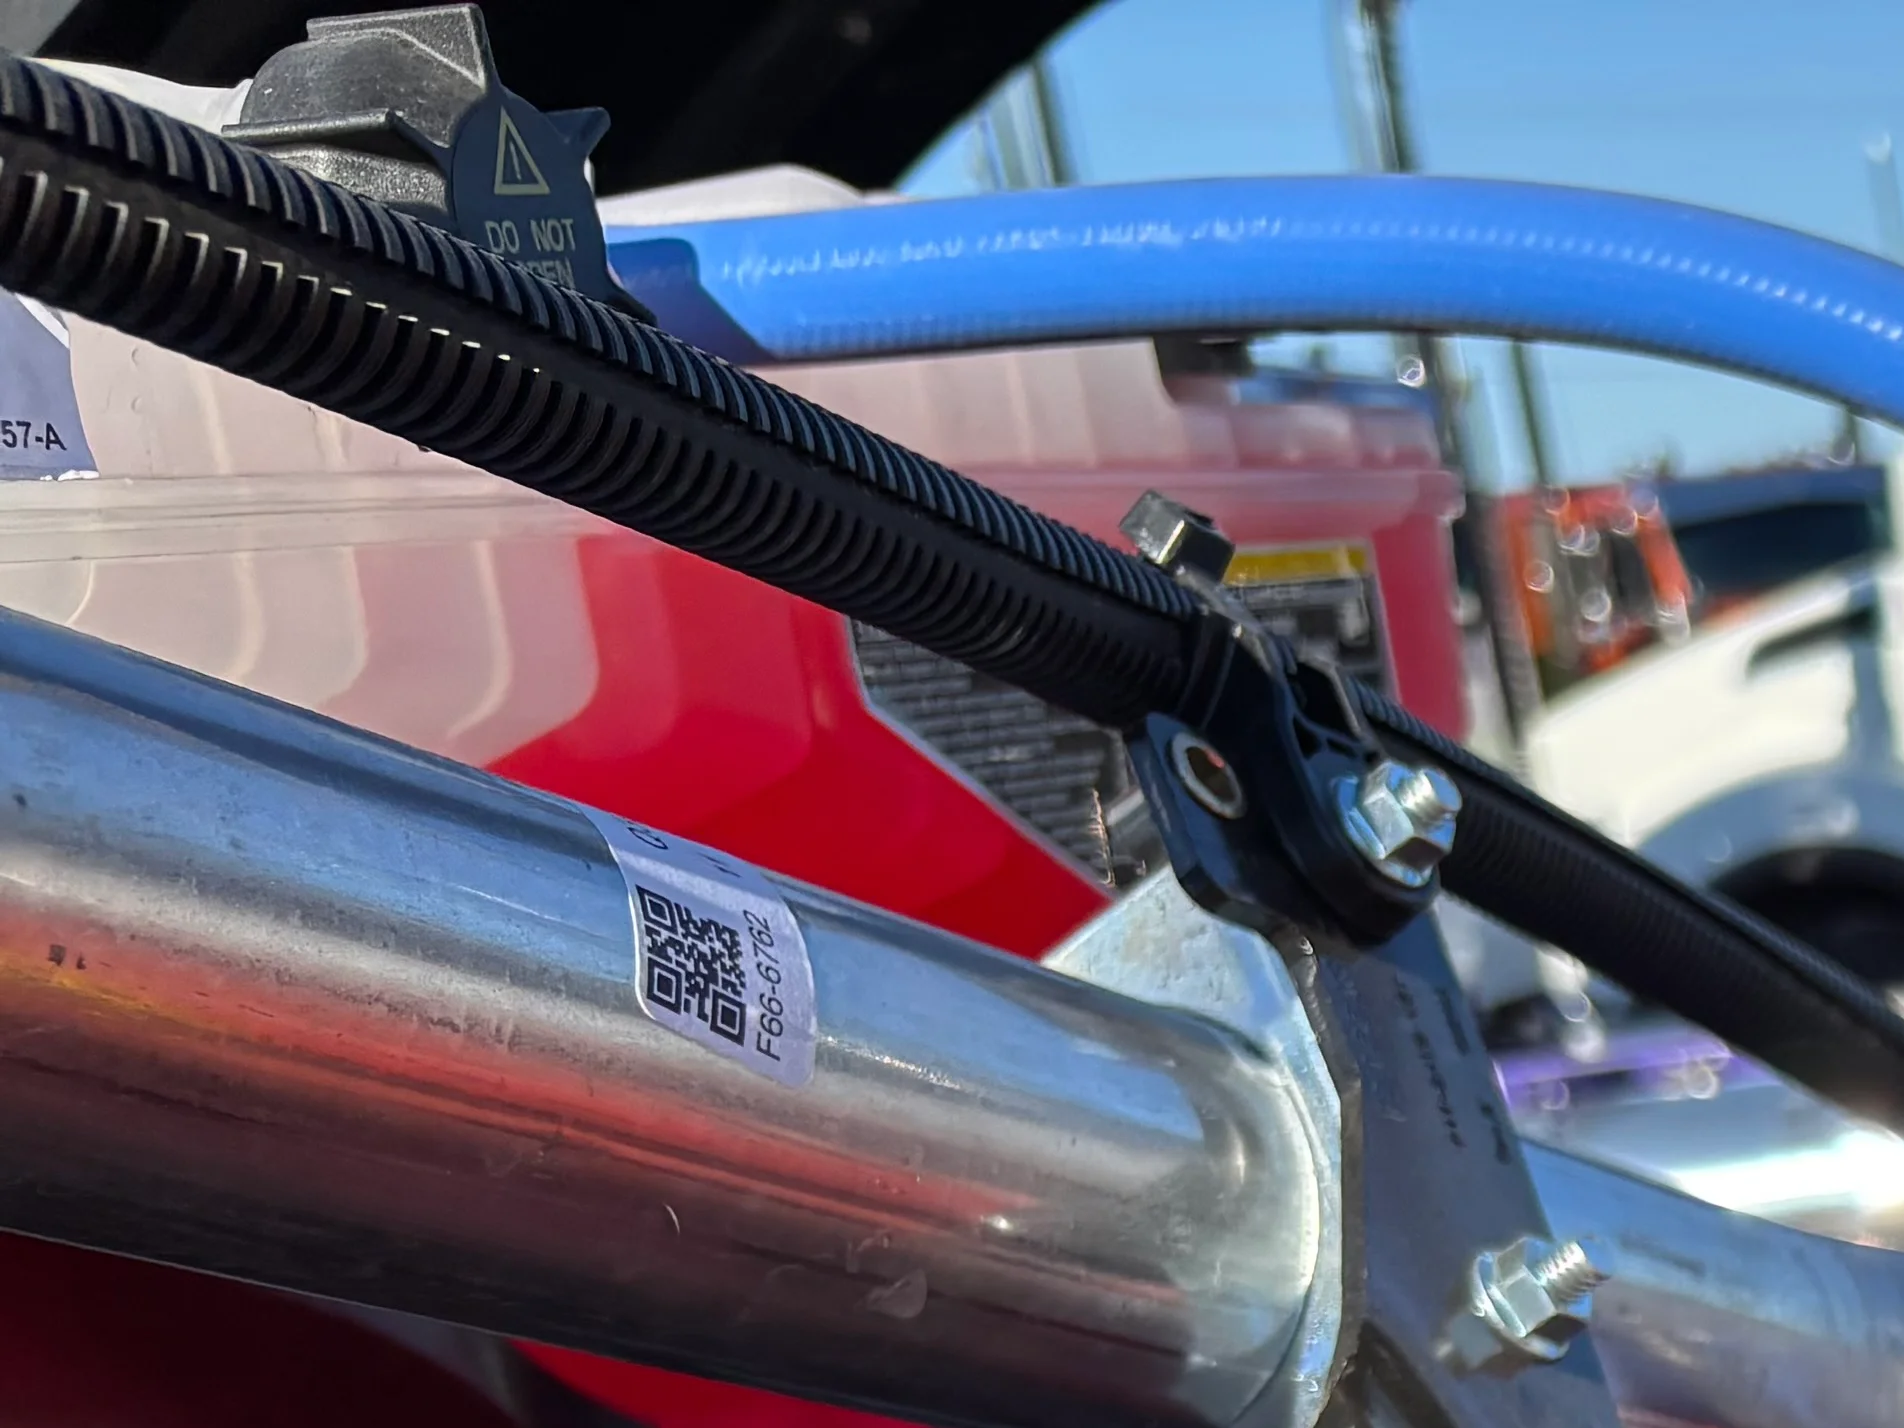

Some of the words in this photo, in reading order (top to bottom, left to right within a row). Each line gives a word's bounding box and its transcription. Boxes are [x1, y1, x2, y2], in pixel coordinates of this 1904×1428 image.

[484, 220, 520, 254] DO
[530, 218, 576, 252] NOT
[518, 257, 576, 290] PEN
[0, 420, 67, 450] 57-A
[743, 909, 784, 1061] F66-6762
